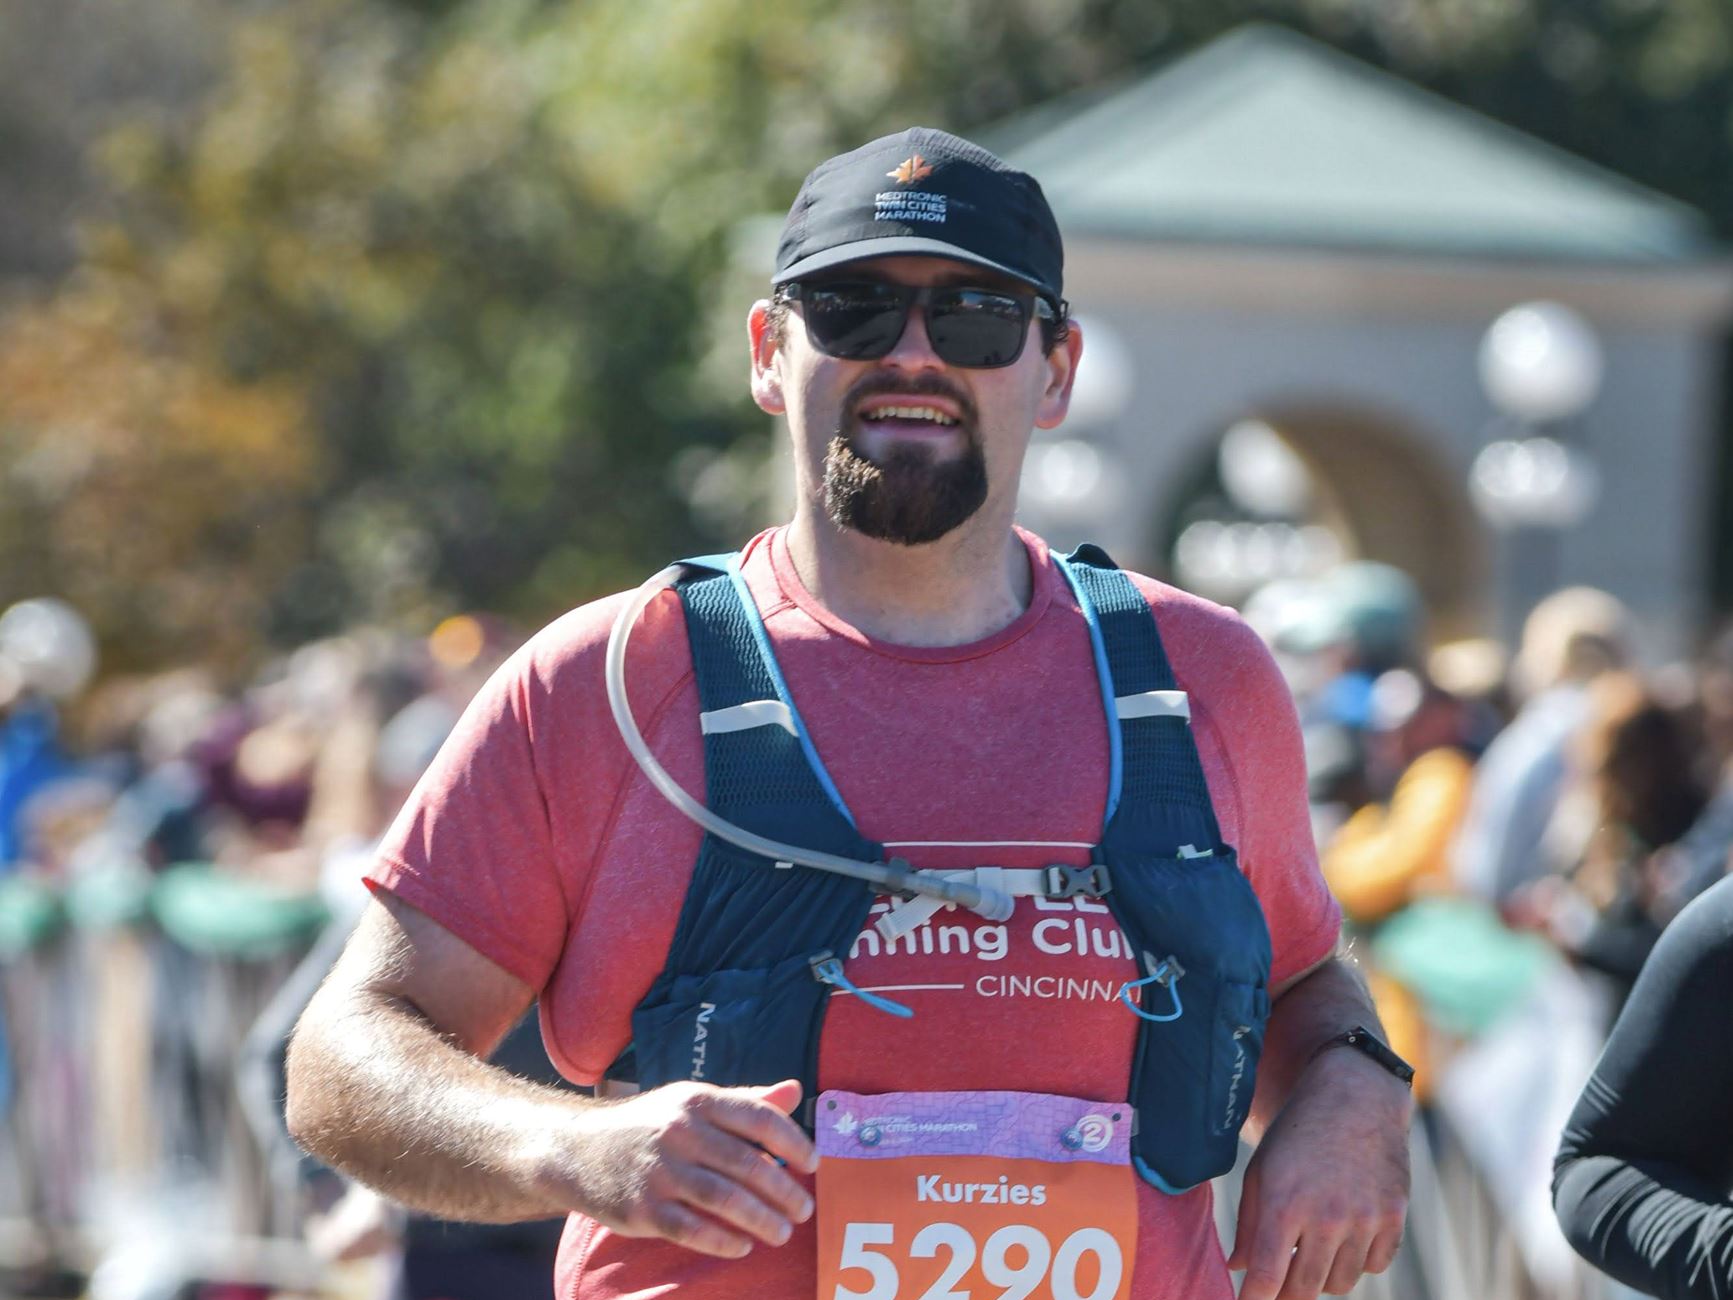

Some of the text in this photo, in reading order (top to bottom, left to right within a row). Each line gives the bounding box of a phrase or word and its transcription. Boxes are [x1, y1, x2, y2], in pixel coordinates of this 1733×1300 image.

[876, 192, 946, 203] MEDTRONIC
[875, 201, 946, 212] TWIN CITIES
[875, 211, 946, 222] MARATHON
[690, 1002, 716, 1081] NATH
[1083, 1122, 1102, 1142] 2
[916, 1174, 1047, 1206] Kurzies
